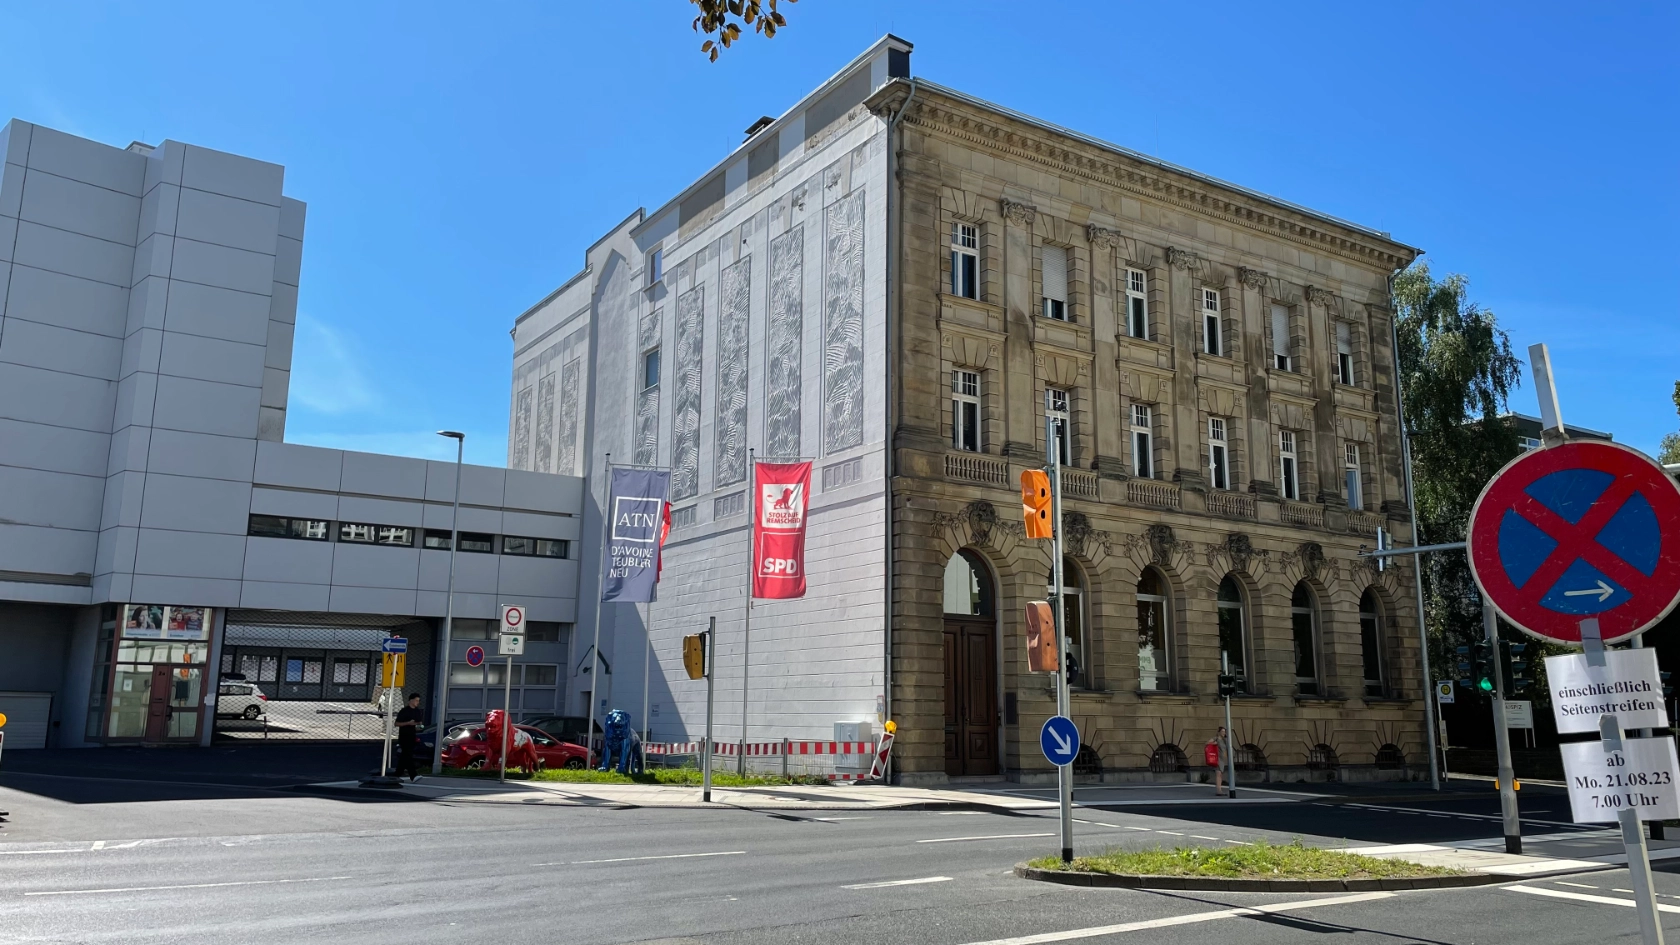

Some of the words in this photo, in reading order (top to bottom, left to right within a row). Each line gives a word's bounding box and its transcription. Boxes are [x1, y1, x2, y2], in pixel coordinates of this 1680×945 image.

[617, 512, 655, 528] ATN
[612, 556, 651, 568] TEUBLER
[763, 557, 797, 574] SPD
[609, 567, 629, 578] NEU
[1558, 680, 1651, 698] einschließlich
[1561, 698, 1655, 716] Seitenstreifen
[1606, 753, 1625, 767] ab
[1574, 775, 1602, 789] Mo.
[1605, 771, 1671, 787] 21.08.23
[1591, 793, 1622, 808] 7.00
[1625, 792, 1660, 807] Uhr
